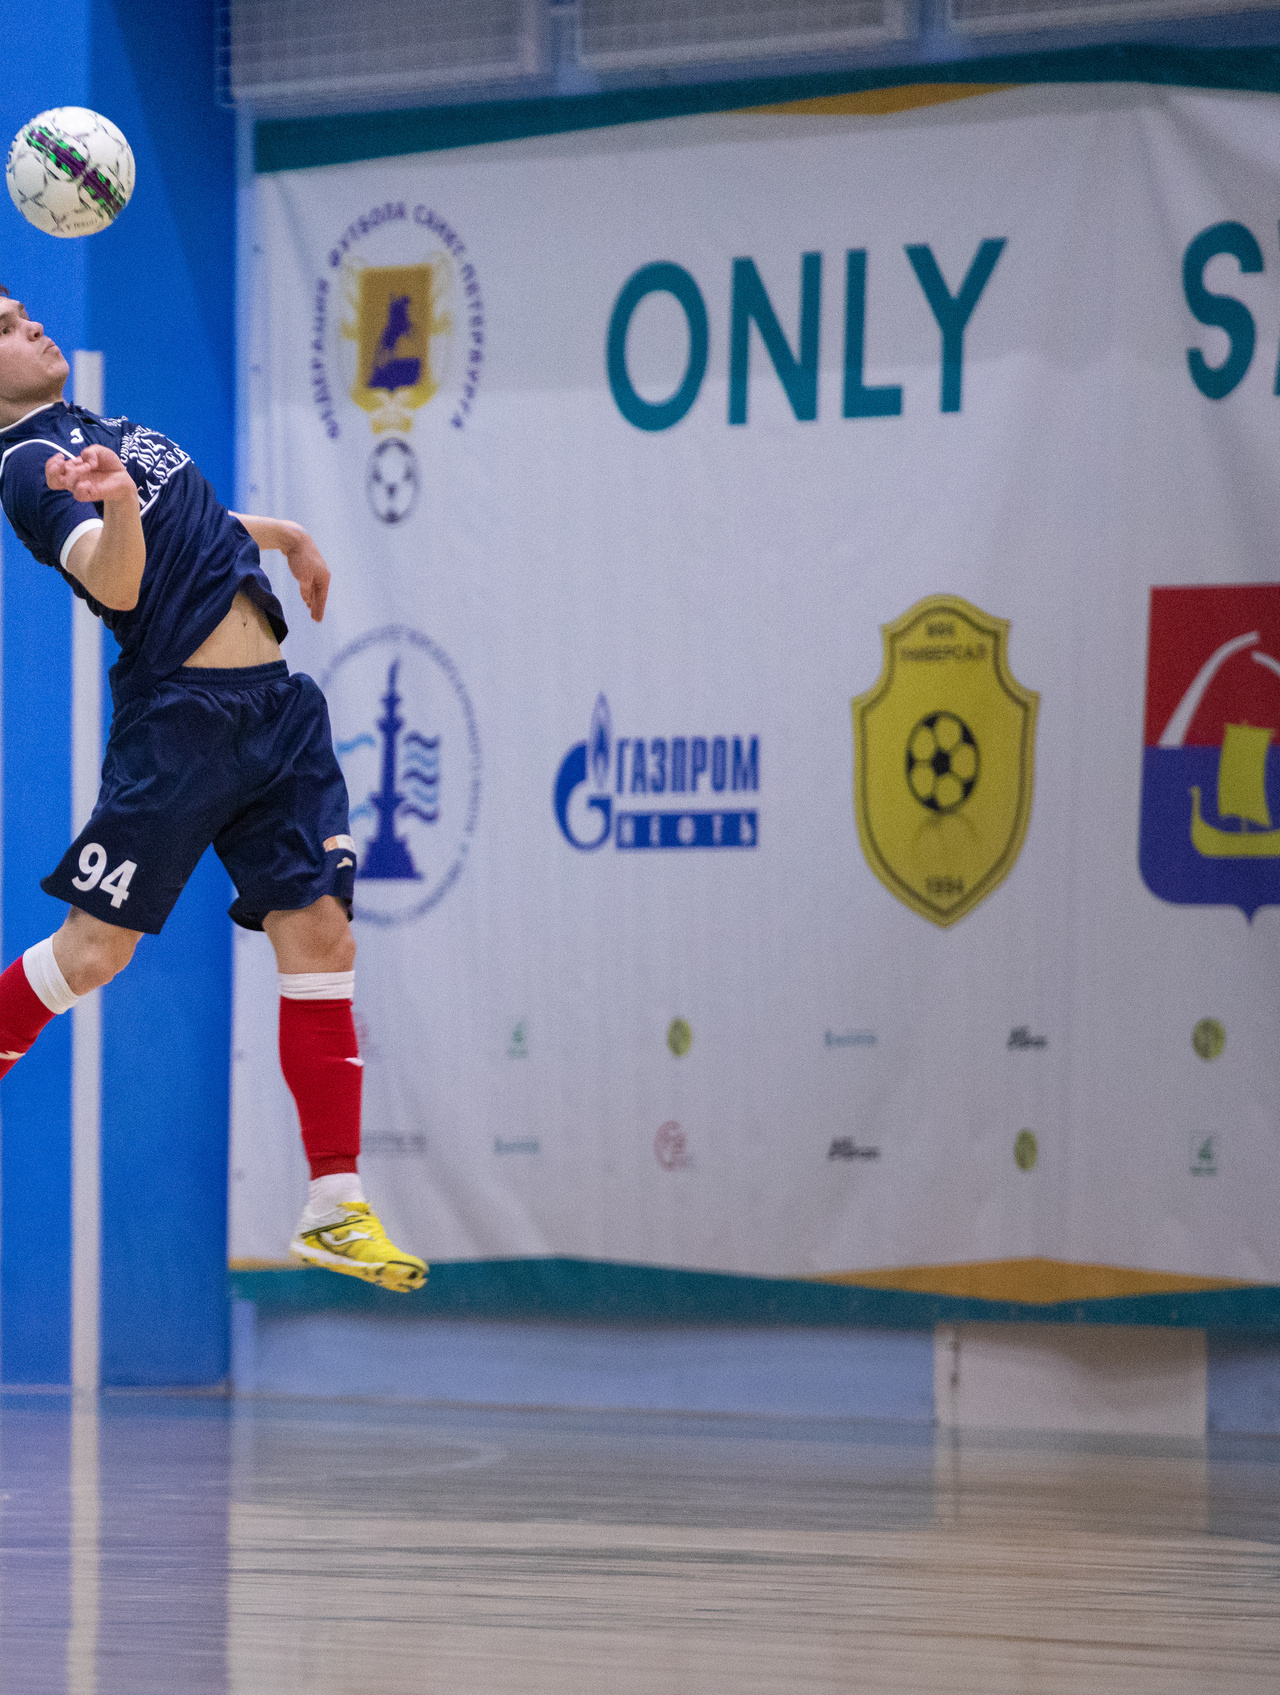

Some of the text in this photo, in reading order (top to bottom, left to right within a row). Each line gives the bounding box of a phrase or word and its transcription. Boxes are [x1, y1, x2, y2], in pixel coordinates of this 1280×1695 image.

[606, 220, 1280, 432] ONLY S
[616, 734, 759, 794] ГАЗПРОМ
[72, 842, 137, 909] 94
